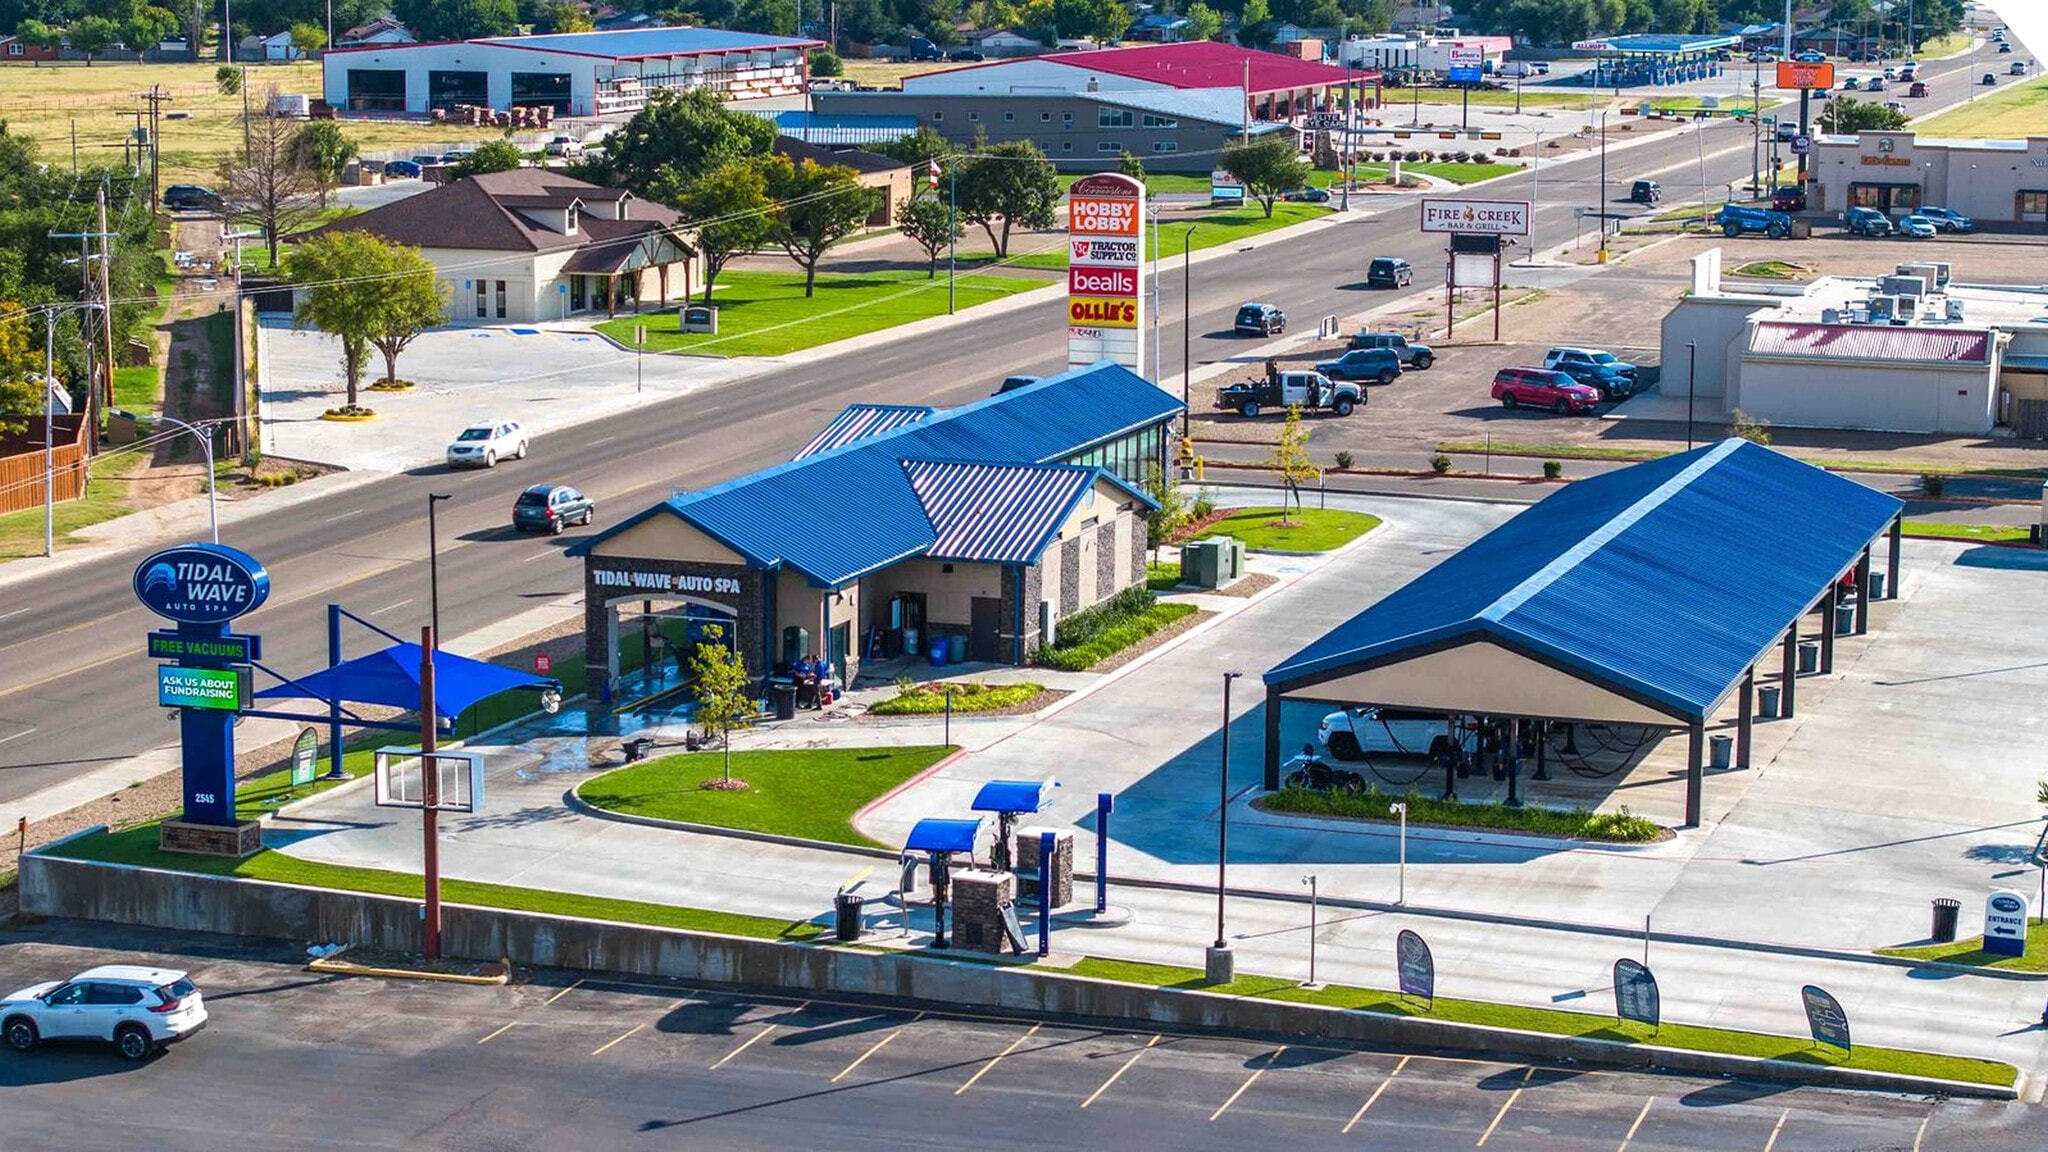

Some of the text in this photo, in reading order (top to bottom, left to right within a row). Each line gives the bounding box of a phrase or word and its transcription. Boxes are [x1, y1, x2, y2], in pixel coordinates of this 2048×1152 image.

[1314, 112, 1339, 121] ELITE
[1073, 202, 1134, 217] HOBBY
[1428, 208, 1521, 225] FIRE CREEK
[1075, 216, 1132, 231] LOBBY
[1091, 241, 1136, 252] TRACTOR
[1091, 251, 1125, 261] SUPPLY
[1074, 270, 1133, 292] bealls
[1071, 302, 1135, 322] OLLIE'S
[177, 563, 234, 582] TIDAL
[593, 569, 741, 593] TIDAL WAVE AUTO SPA
[187, 583, 247, 602] WAVE
[165, 603, 229, 612] AUTO SPA
[152, 639, 244, 658] FREE VACUUMS
[163, 676, 235, 690] ASK US ABOUT
[164, 685, 234, 699] FUNDRAISING
[195, 793, 215, 804] 2545
[1988, 915, 2022, 926] ENTRANCE
